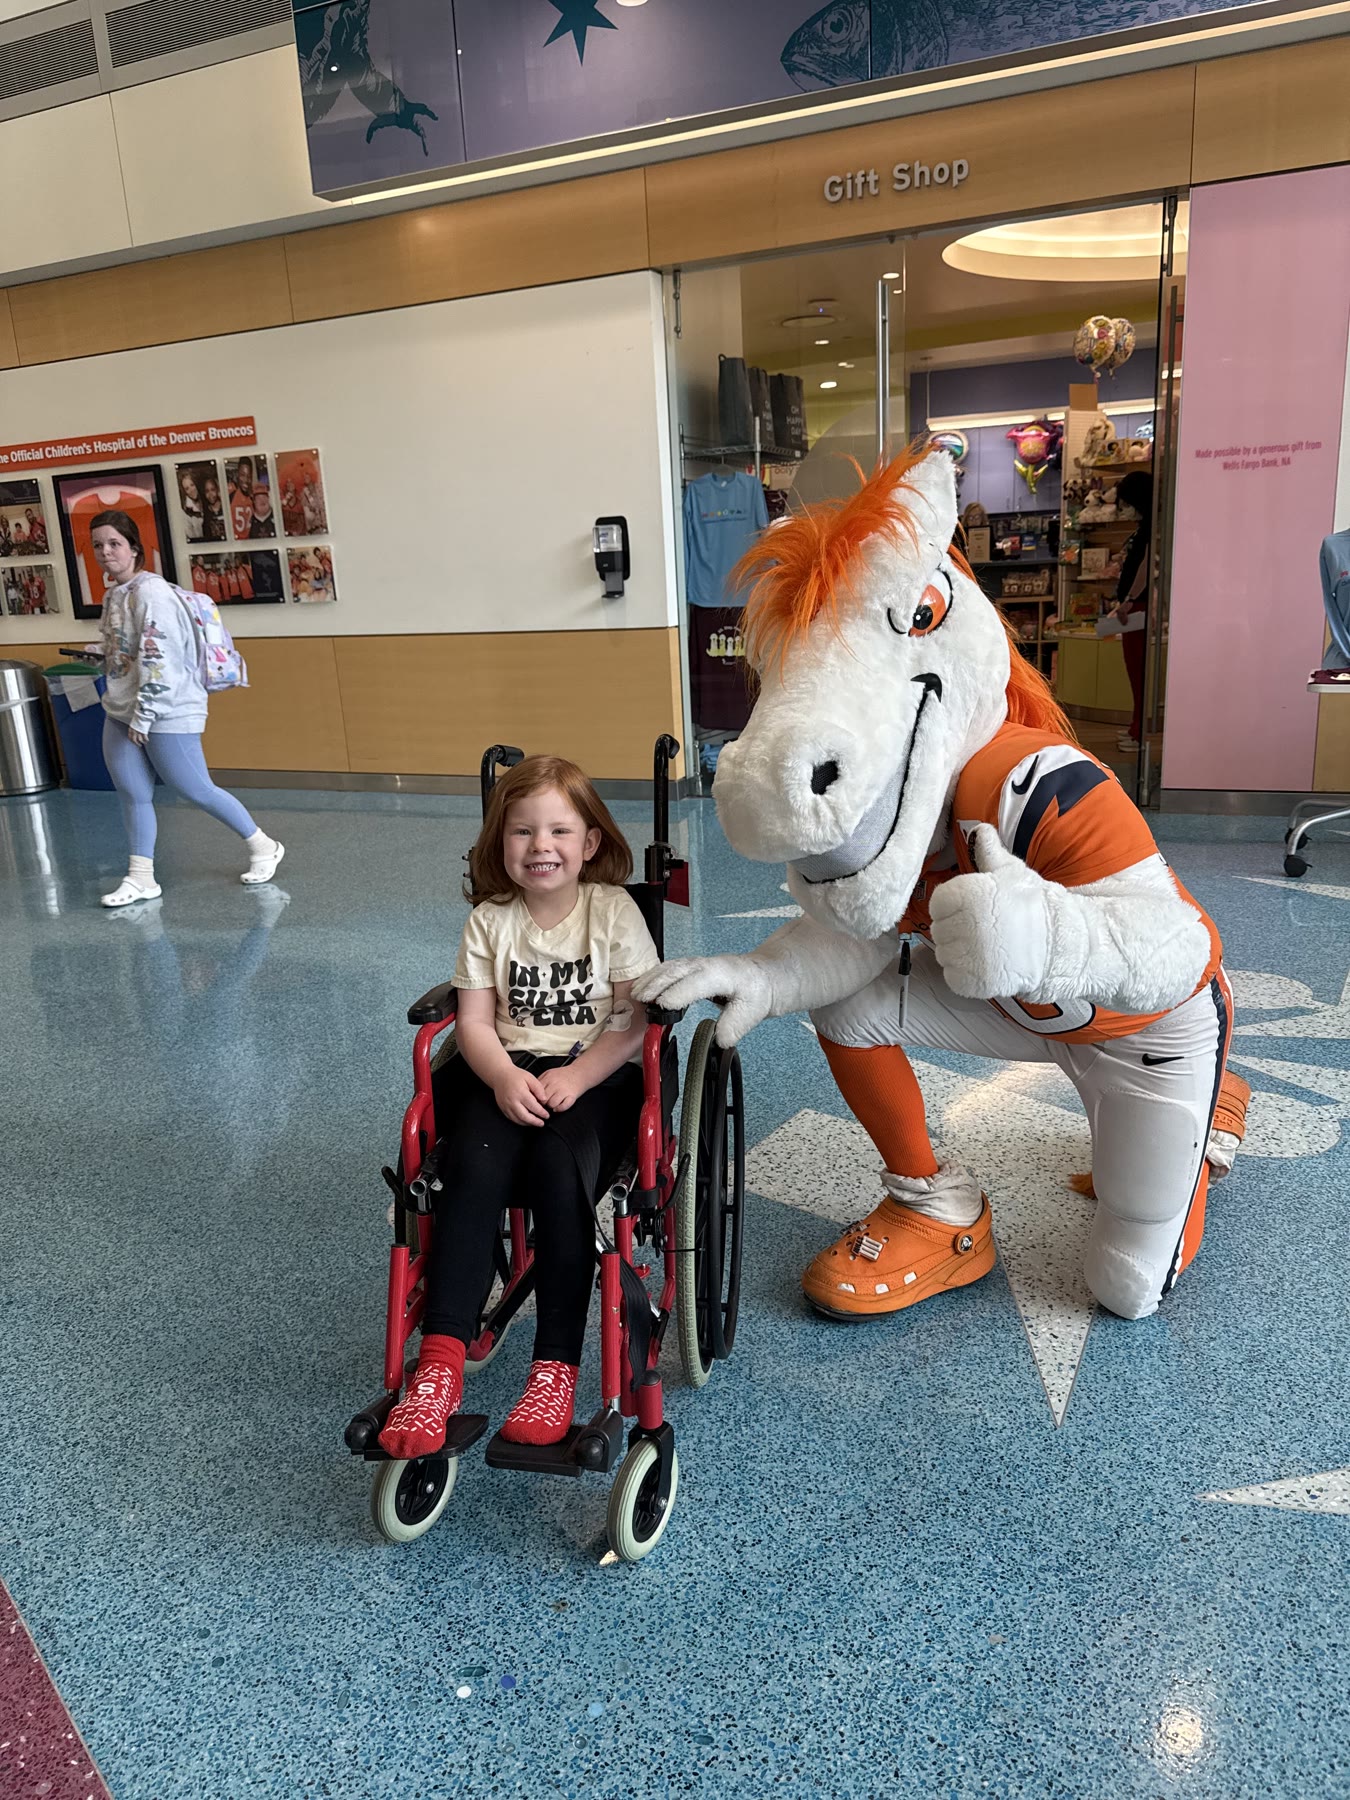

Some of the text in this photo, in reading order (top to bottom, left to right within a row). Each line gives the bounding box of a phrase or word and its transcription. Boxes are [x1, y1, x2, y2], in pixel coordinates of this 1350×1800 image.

[823, 159, 969, 203] Gift Shop
[10, 447, 44, 463] Official
[45, 443, 92, 459] Children's
[93, 437, 136, 454] Hospital
[137, 435, 148, 448] of
[149, 434, 167, 447] the
[169, 431, 206, 445] Denver
[208, 425, 254, 440] Broncos
[1195, 440, 1322, 459] Made possible by a generous gift from
[1223, 460, 1240, 471] Wells
[1241, 460, 1260, 470] Fargo
[1281, 457, 1291, 466] NA
[508, 954, 592, 989] IN MY
[508, 983, 594, 1009] SILLY
[530, 1005, 597, 1027] ERA
